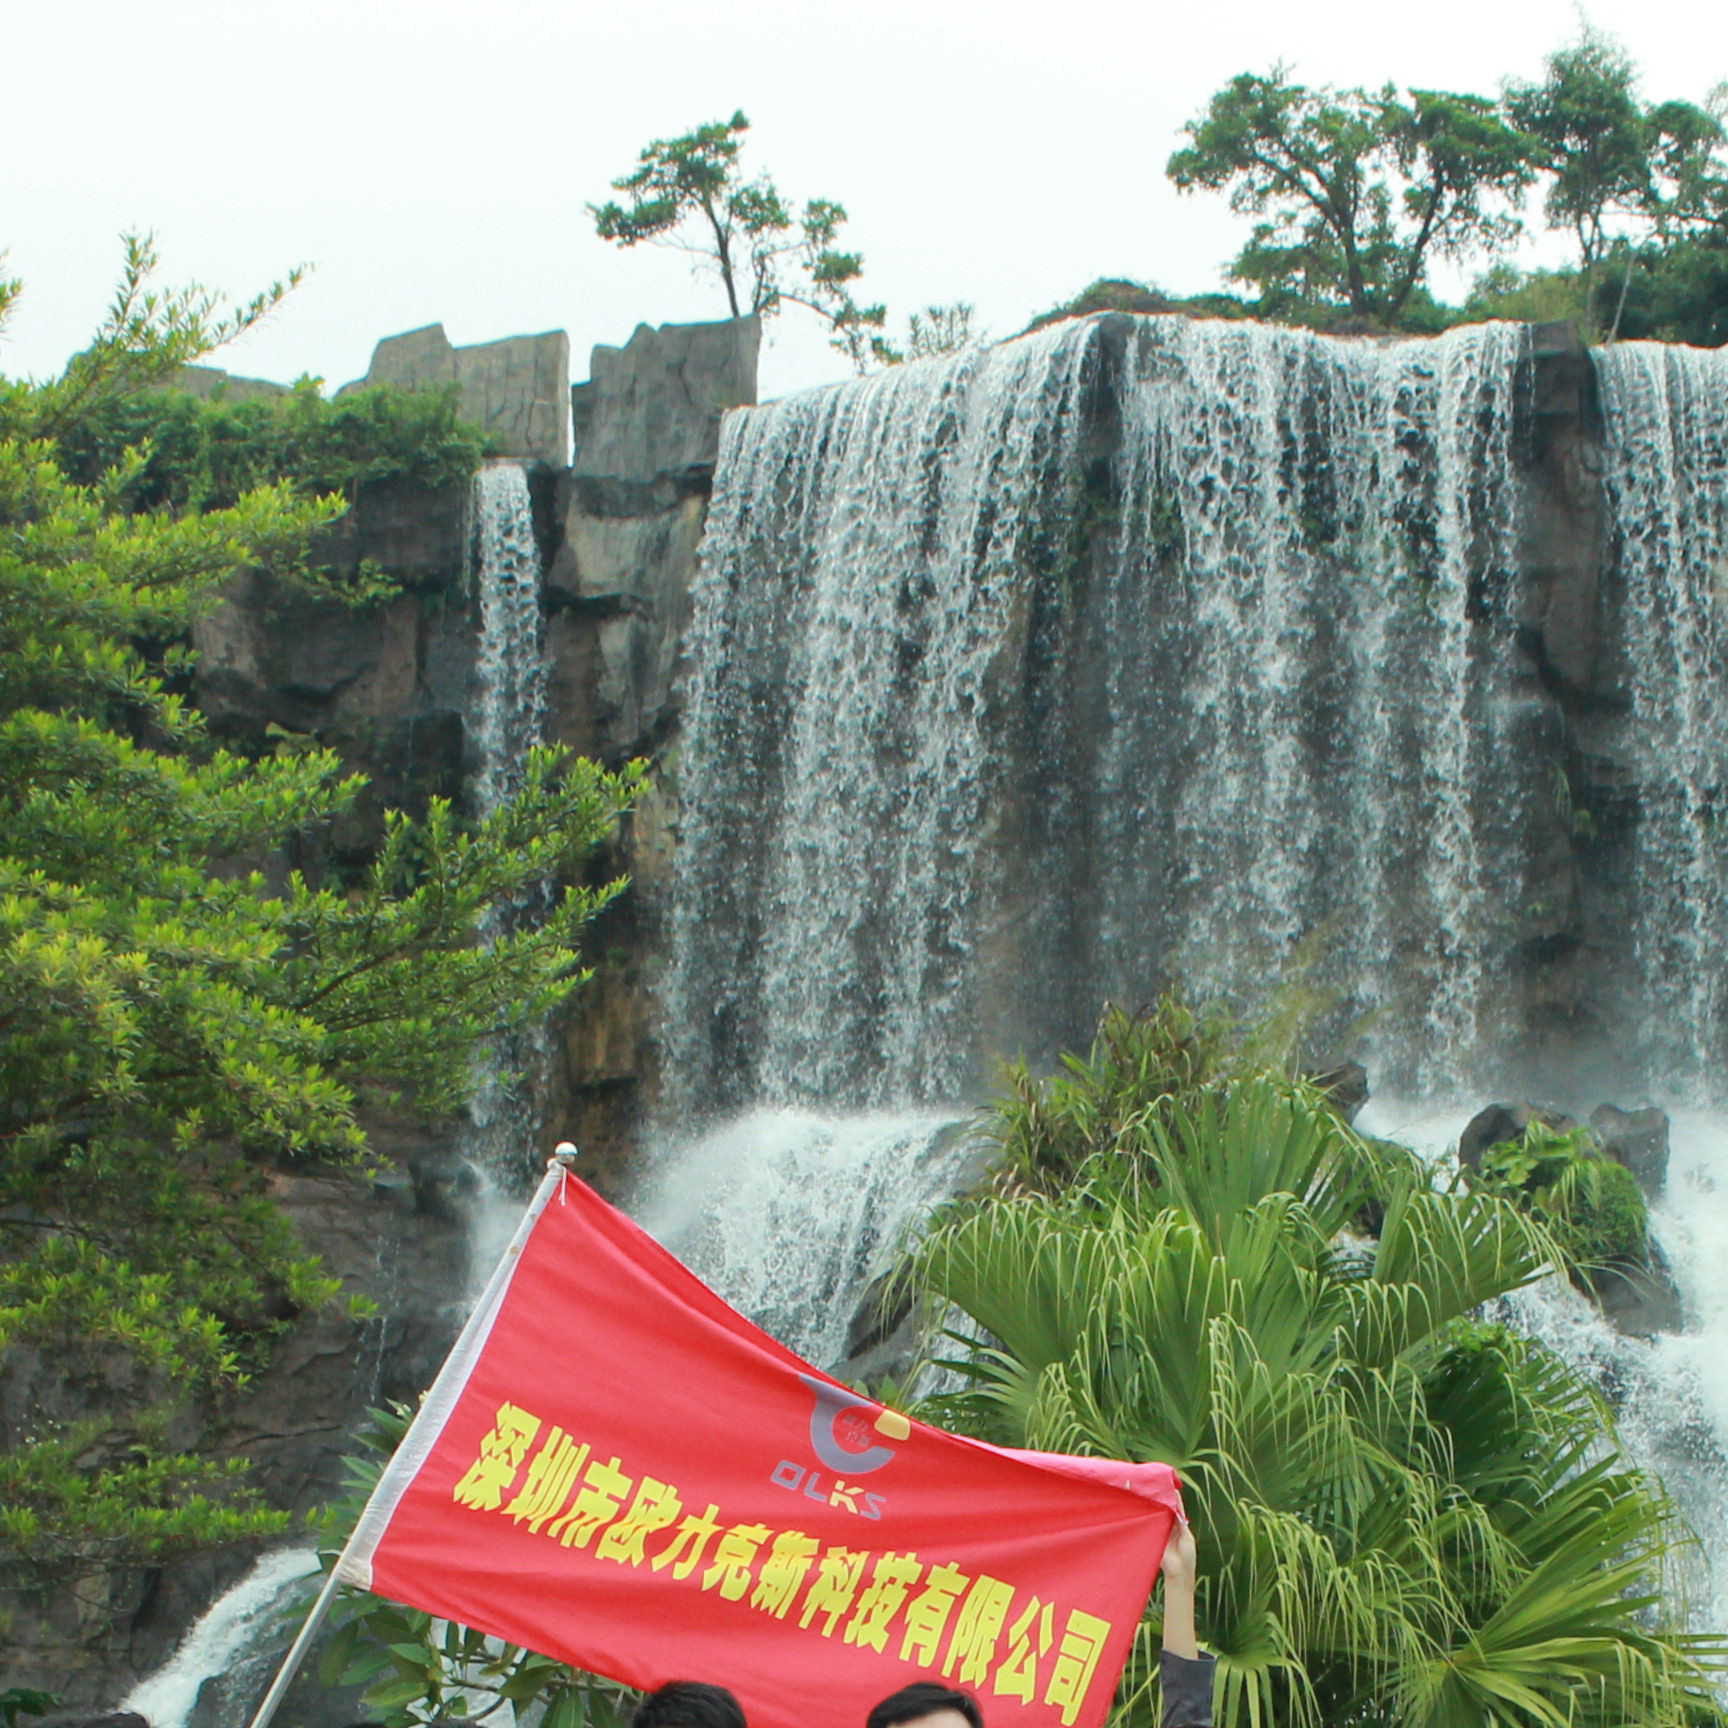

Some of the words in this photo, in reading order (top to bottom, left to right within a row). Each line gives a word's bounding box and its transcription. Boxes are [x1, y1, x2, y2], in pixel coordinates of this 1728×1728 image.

[453, 1401, 1112, 1727] 深圳市欧力克斯科技有限公司
[770, 1459, 887, 1521] OLKS
